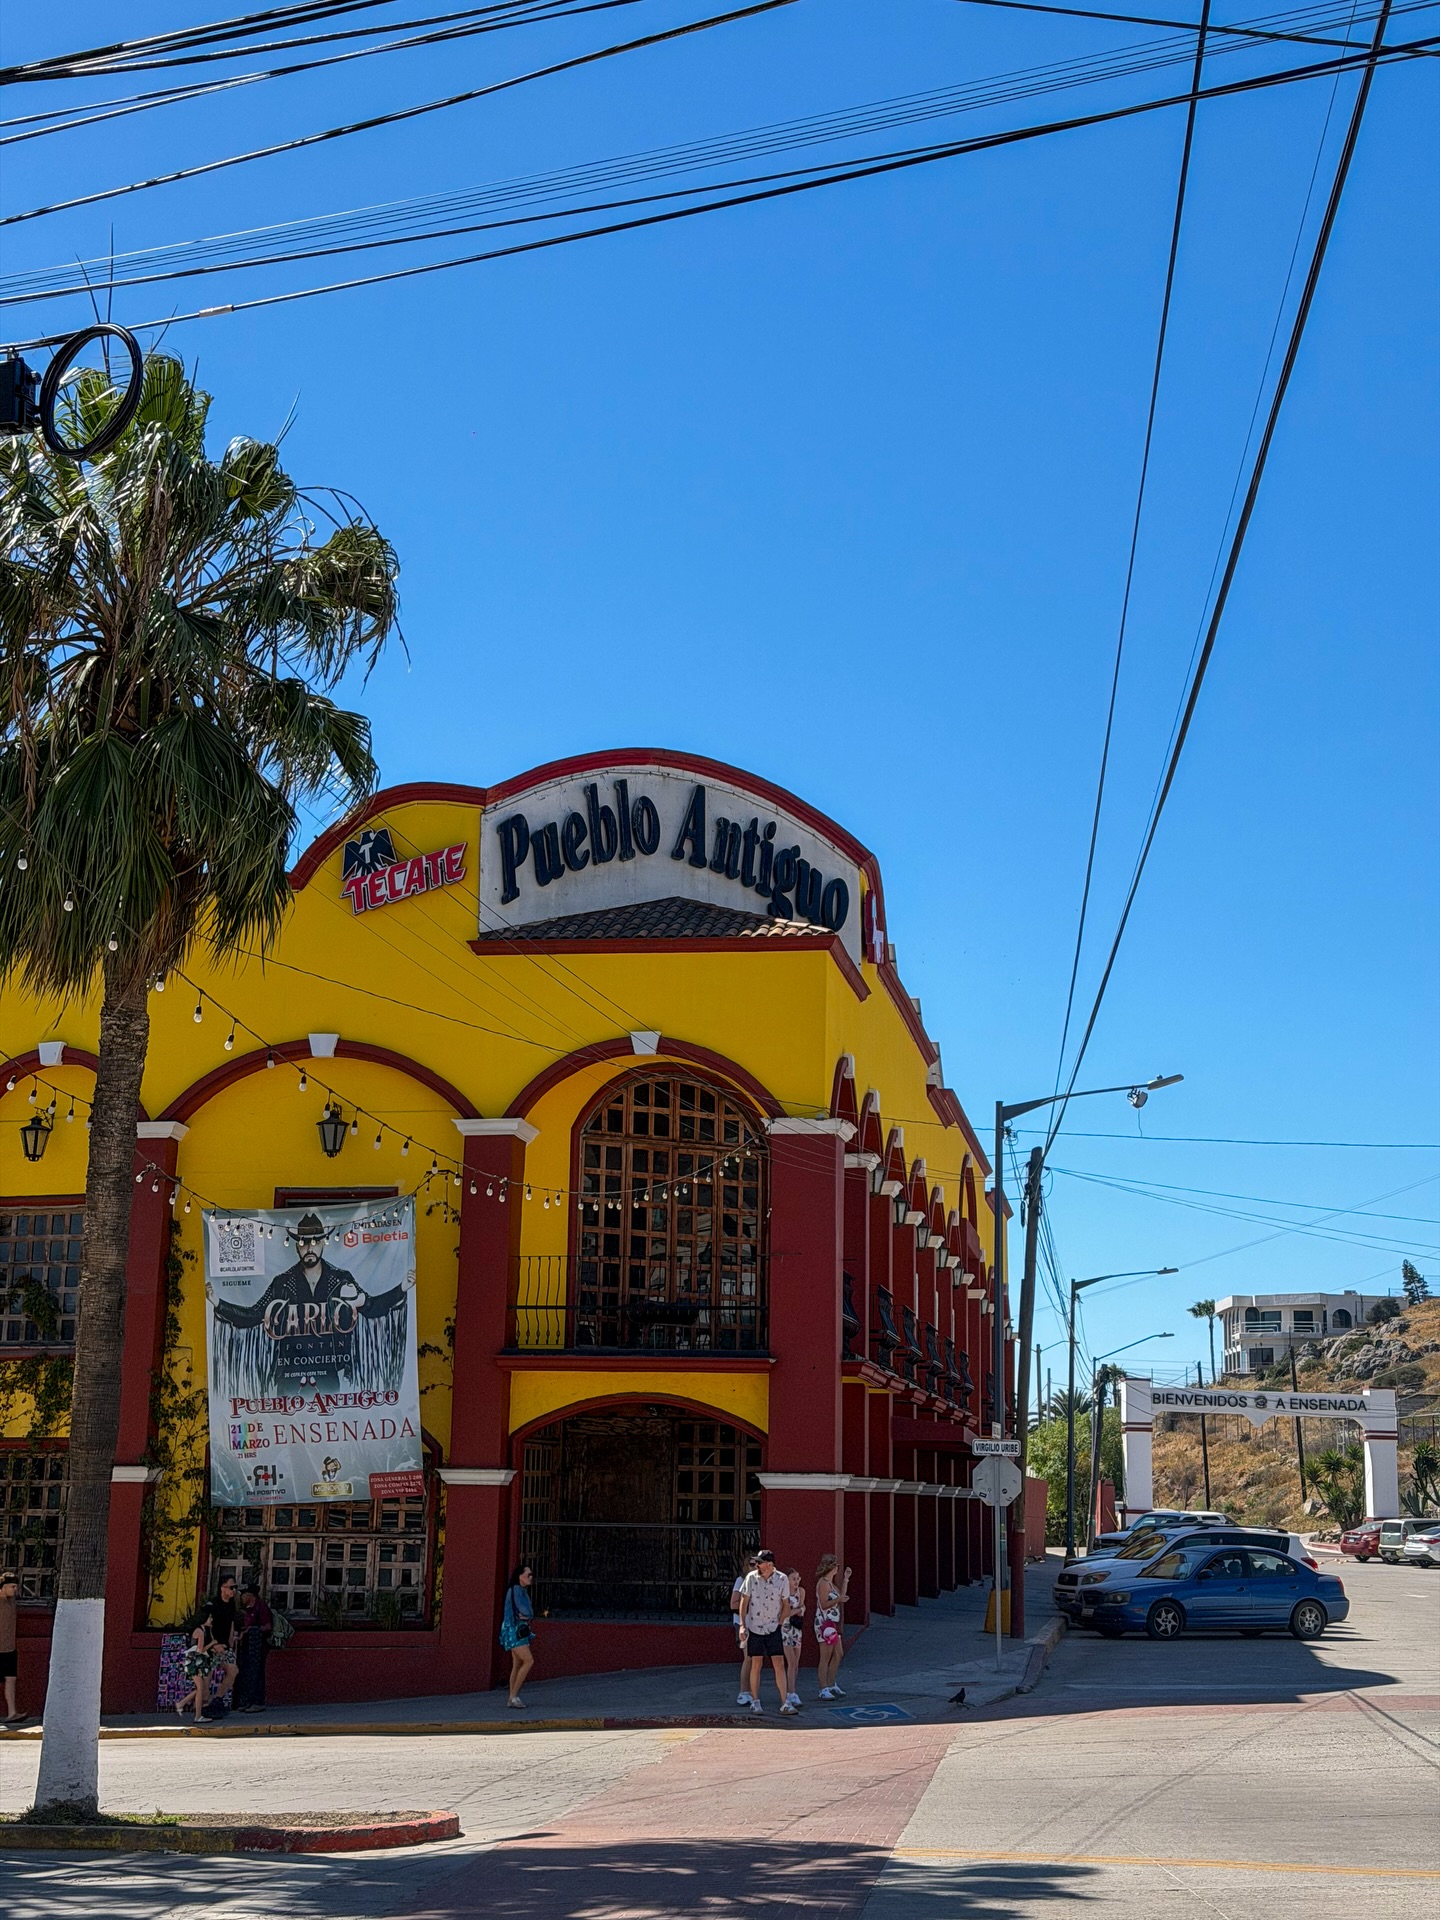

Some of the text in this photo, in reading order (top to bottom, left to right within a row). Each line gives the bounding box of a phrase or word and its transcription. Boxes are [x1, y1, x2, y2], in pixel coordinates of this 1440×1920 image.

[497, 779, 849, 932] Pueblo Antiguo
[340, 842, 467, 915] TECATE
[362, 1231, 409, 1243] Boletia
[262, 1298, 358, 1340] CARLO
[277, 1354, 351, 1366] EN CONCIERTO
[230, 1390, 399, 1418] PUEBLO ANTIGUO
[1152, 1393, 1368, 1411] BIENVENIDOS A ENSENADA
[231, 1423, 264, 1434] 21 DE
[273, 1417, 416, 1445] ENSENADA
[232, 1438, 270, 1450] MARZO
[976, 1443, 1018, 1453] VIRGILIO URIBE
[257, 1488, 286, 1496] POSITIVO
